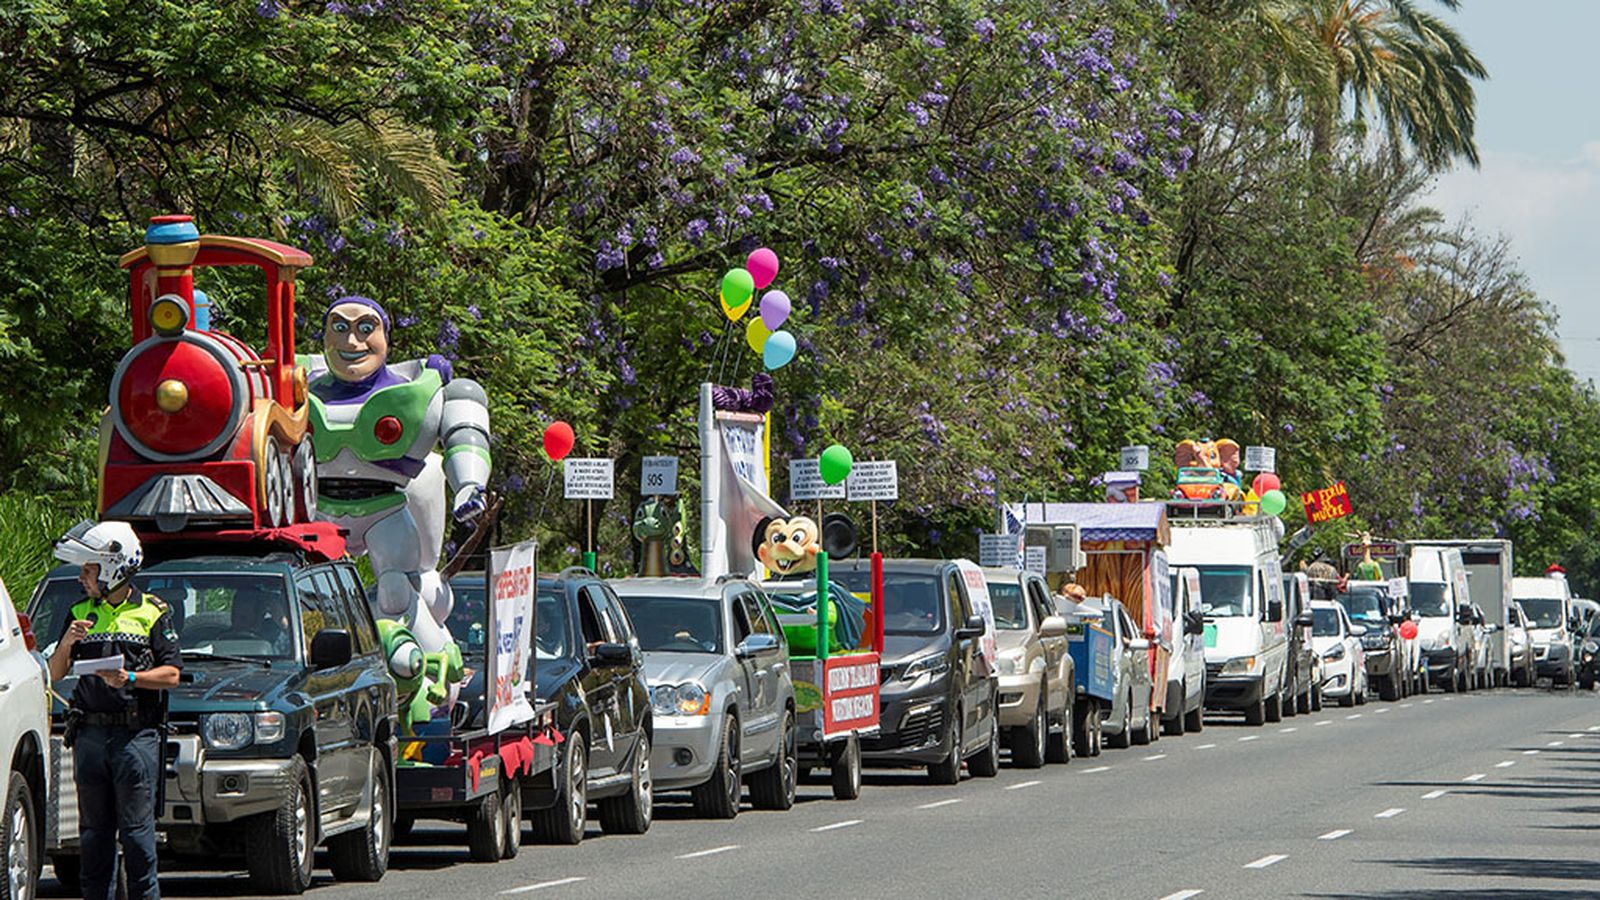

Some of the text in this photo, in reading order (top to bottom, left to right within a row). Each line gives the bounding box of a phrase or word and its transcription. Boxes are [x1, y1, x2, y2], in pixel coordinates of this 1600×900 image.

[647, 473, 664, 487] SOS
[1301, 483, 1346, 505] LA FERIA
[1312, 504, 1345, 521] MUERE
[1320, 499, 1333, 511] SE
